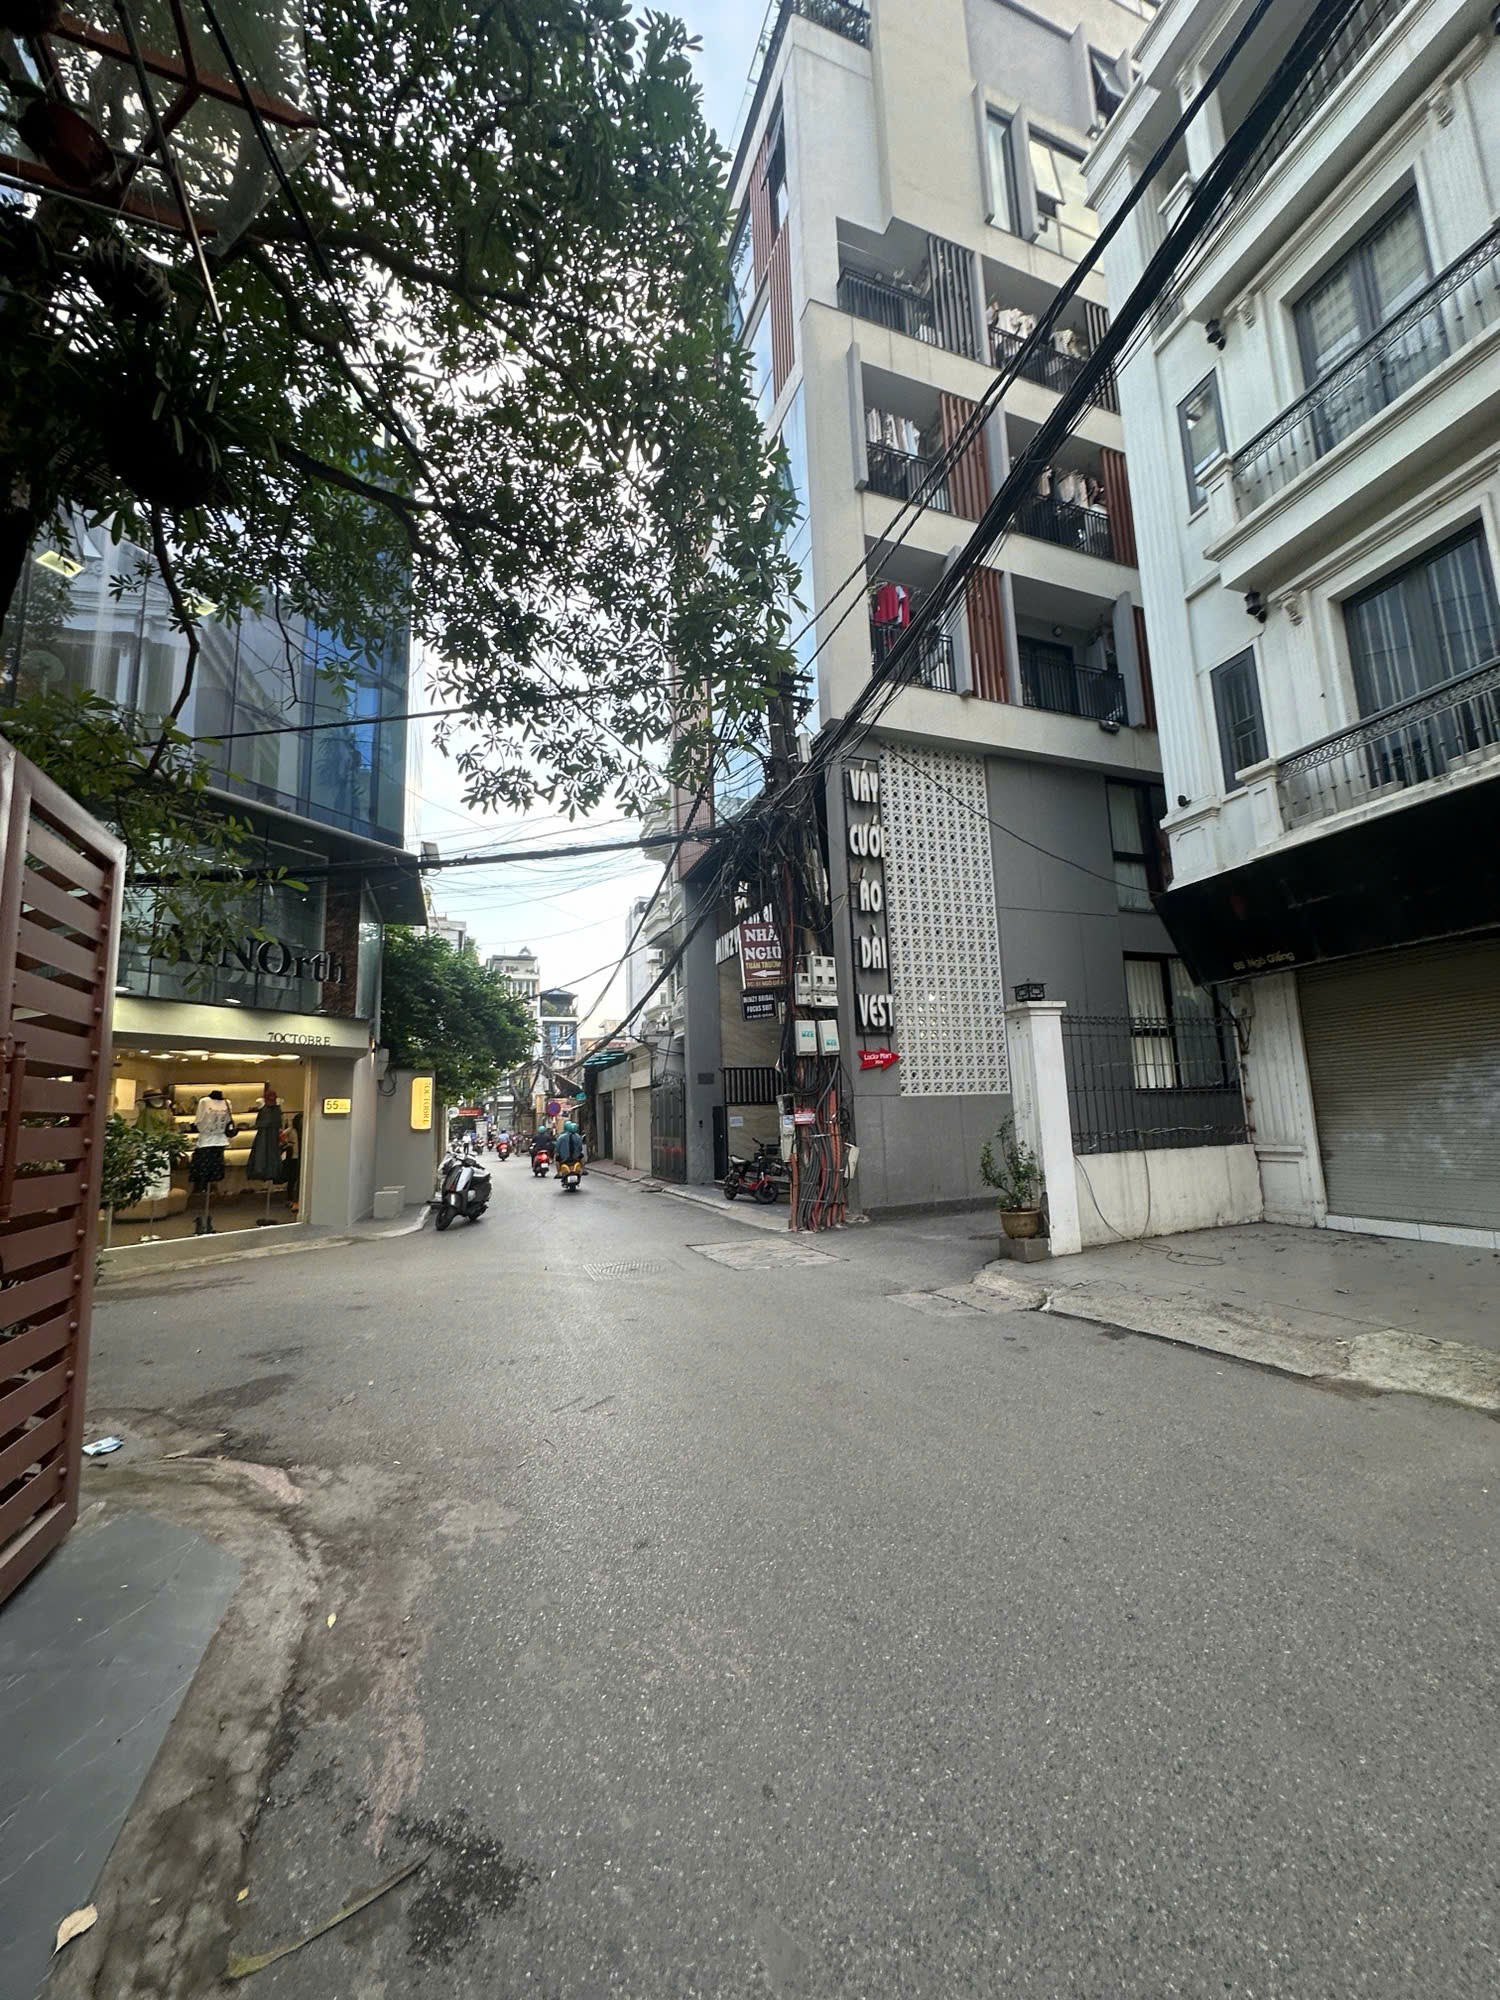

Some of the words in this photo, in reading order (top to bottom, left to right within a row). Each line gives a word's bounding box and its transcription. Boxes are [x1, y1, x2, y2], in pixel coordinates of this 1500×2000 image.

[850, 760, 878, 803] VÁY
[849, 814, 885, 858] CƯỚI
[859, 867, 882, 913] ÁO
[861, 924, 887, 968] DÀI
[858, 993, 894, 1028] VEST
[268, 1032, 332, 1047] 7OCTOBRE
[325, 1100, 340, 1110] 55
